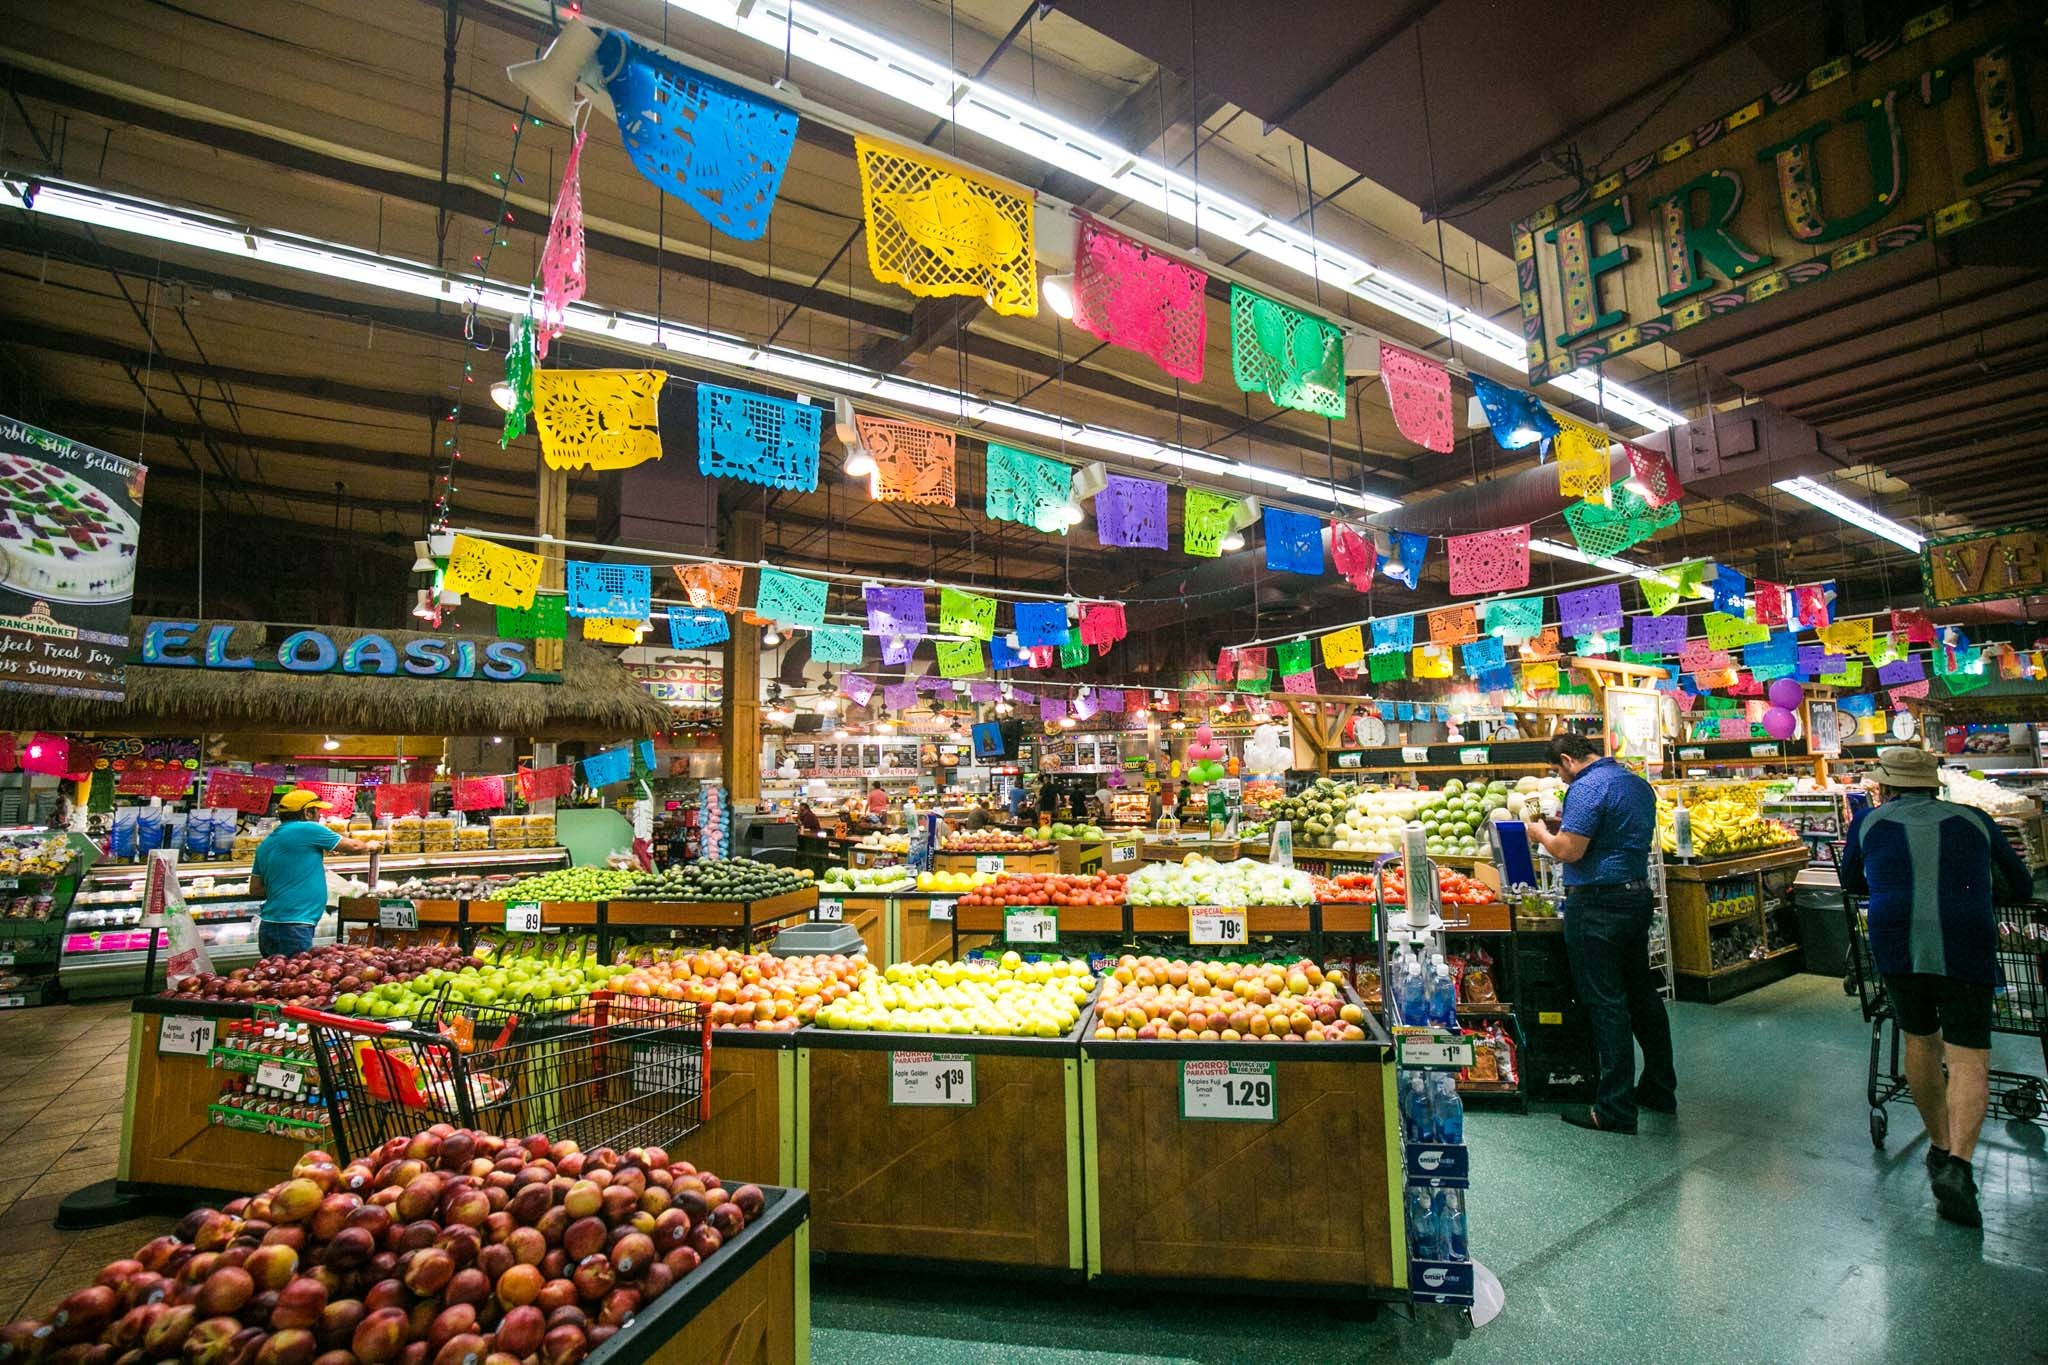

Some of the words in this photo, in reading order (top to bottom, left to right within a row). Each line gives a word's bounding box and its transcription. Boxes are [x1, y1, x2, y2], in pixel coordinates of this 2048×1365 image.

[0, 423, 36, 445] rble
[42, 437, 80, 459] Style
[84, 452, 131, 477] Gelatin
[36, 625, 76, 637] MARKET
[43, 642, 82, 659] Treat
[87, 649, 113, 665] For
[141, 621, 255, 669] EL
[277, 631, 527, 680] OASIS
[26, 660, 86, 680] Summer
[622, 664, 723, 682] abores
[1219, 919, 1240, 939] 79¢
[1093, 959, 1119, 969] RUFFLE
[1186, 1062, 1228, 1070] AHORROS
[1223, 1081, 1271, 1106] 1.29
